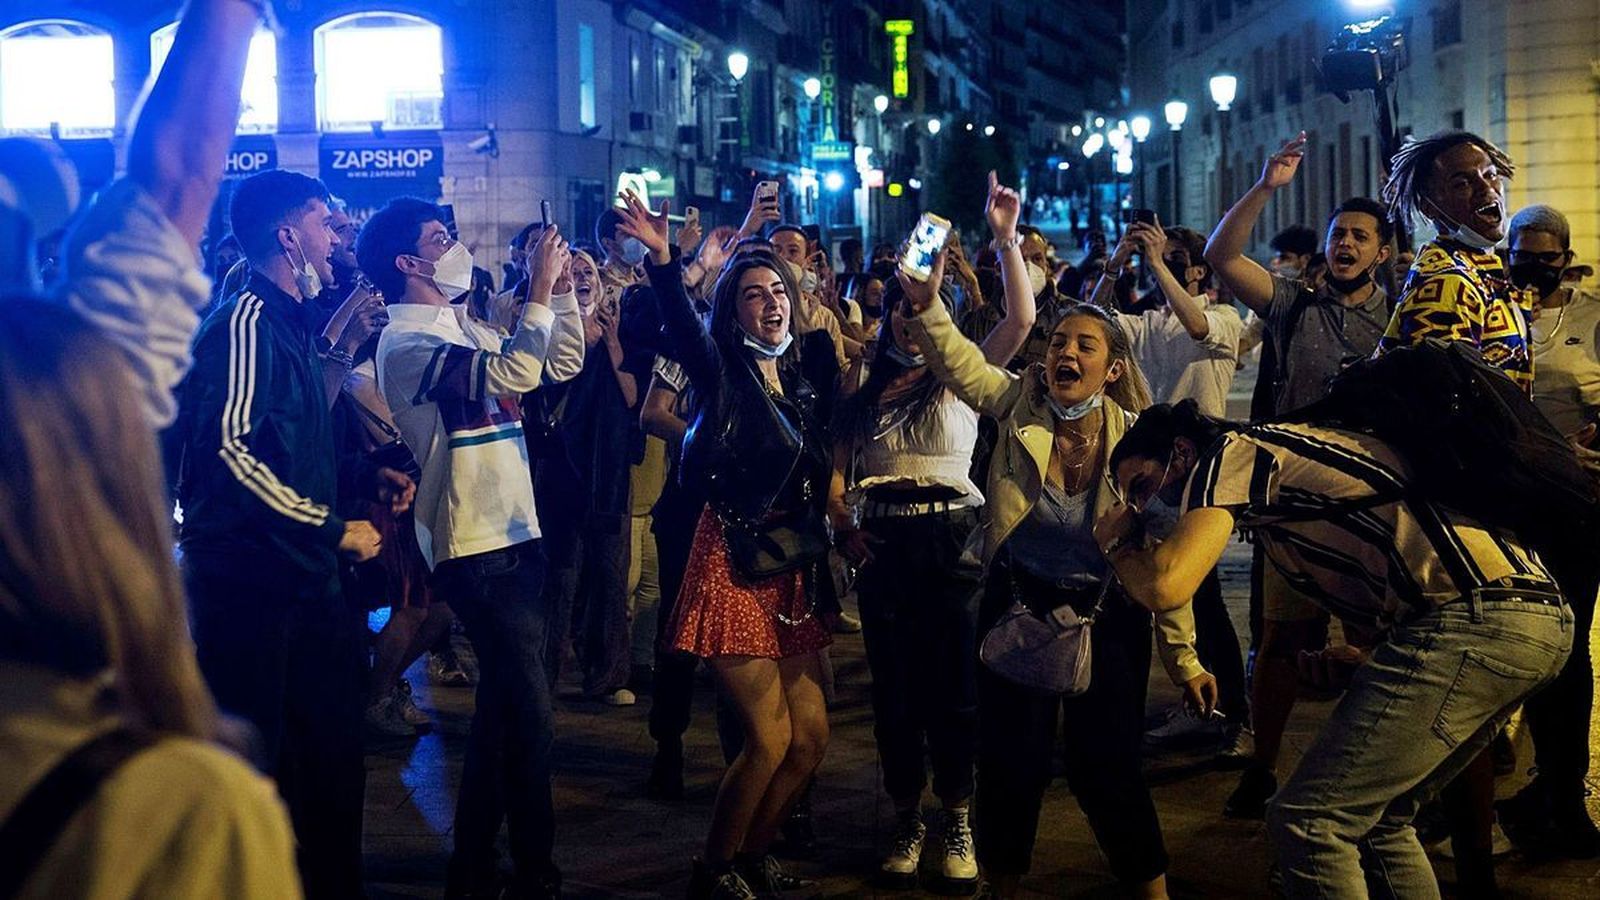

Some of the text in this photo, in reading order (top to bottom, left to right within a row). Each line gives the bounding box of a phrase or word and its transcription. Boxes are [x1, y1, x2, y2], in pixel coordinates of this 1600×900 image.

[821, 4, 835, 142] VICTORIA
[225, 151, 269, 171] HOP
[332, 148, 433, 169] ZAPSHOP
